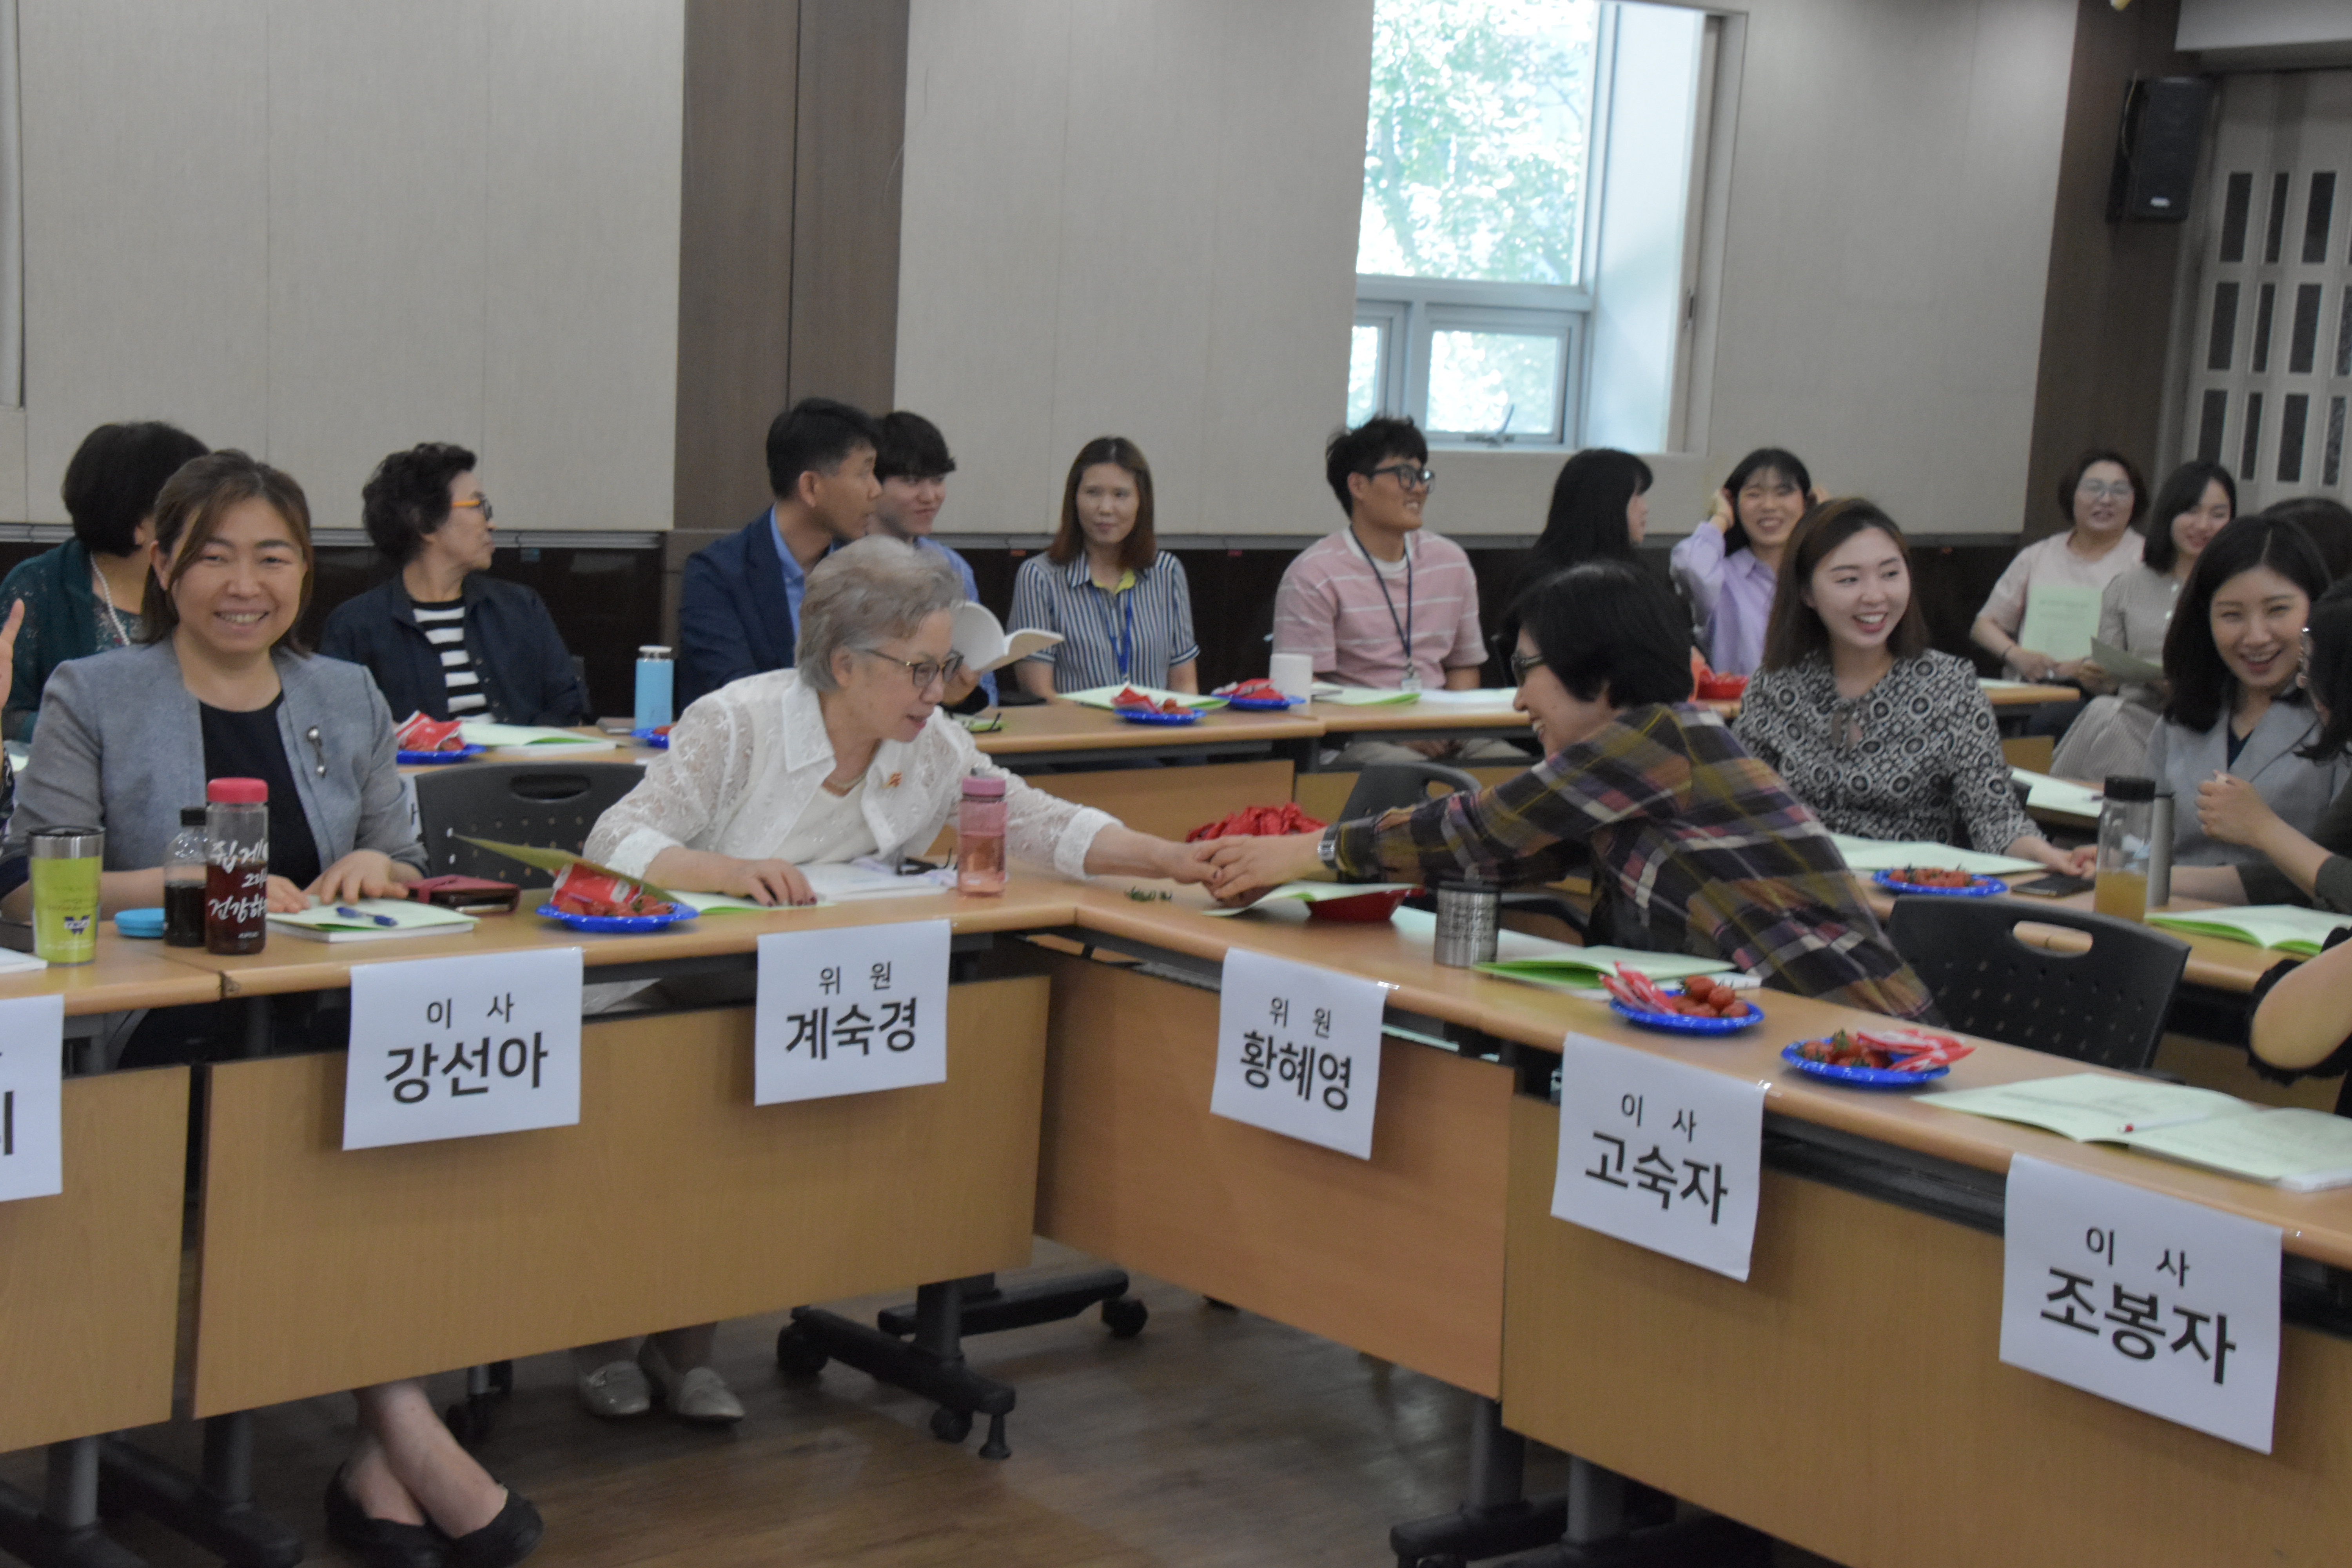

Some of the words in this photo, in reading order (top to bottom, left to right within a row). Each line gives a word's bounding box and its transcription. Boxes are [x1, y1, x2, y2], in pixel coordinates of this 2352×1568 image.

[208, 893, 267, 923] 건강하
[819, 966, 840, 995] 위
[870, 961, 891, 991] 원
[427, 998, 452, 1029] 이
[486, 993, 514, 1023] 사
[785, 996, 917, 1060] 계숙경
[1270, 997, 1289, 1028] 위
[1313, 1008, 1331, 1039] 원
[384, 1031, 549, 1105] 강선아
[1240, 1030, 1352, 1112] 황혜영
[1621, 1094, 1644, 1127] 이
[1671, 1109, 1697, 1143] 사
[1584, 1131, 1729, 1227] 고숙자
[2085, 1226, 2115, 1267] 이
[2156, 1248, 2190, 1289] 사
[2040, 1266, 2237, 1386] 조봉자
